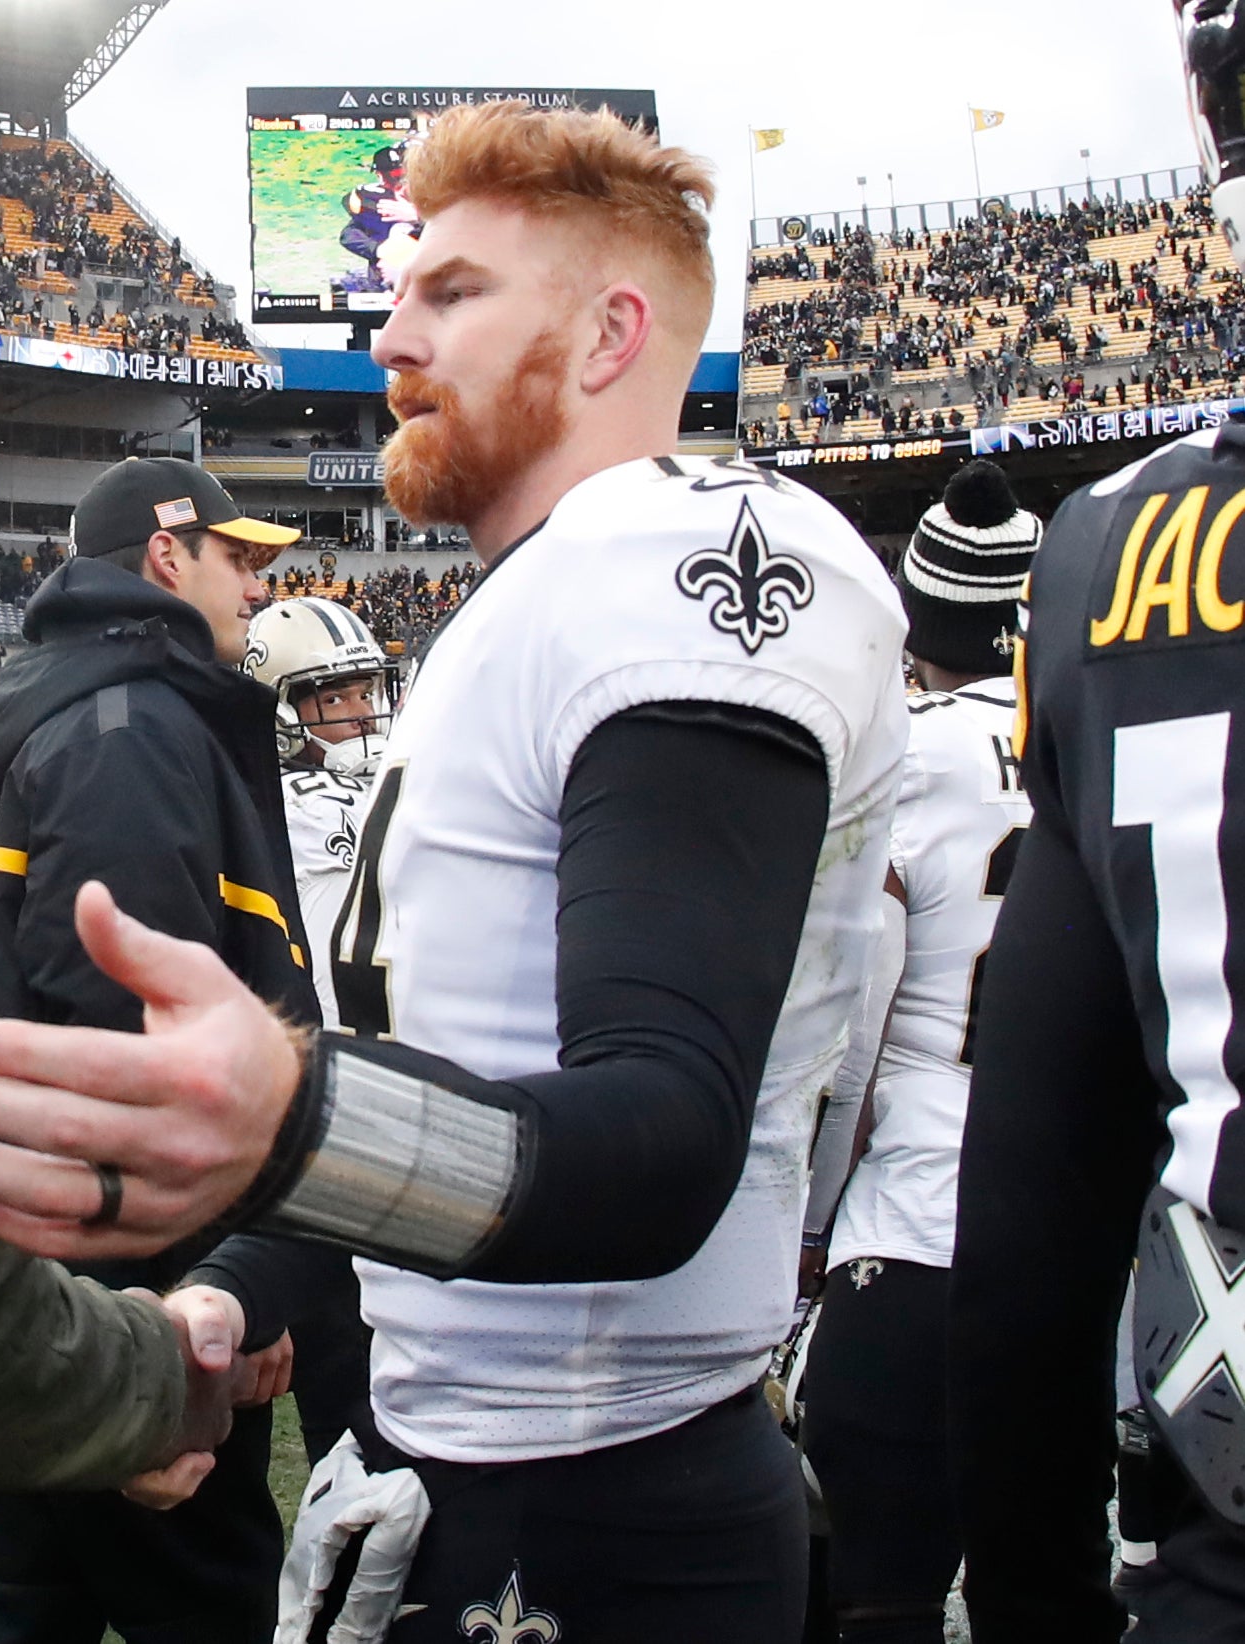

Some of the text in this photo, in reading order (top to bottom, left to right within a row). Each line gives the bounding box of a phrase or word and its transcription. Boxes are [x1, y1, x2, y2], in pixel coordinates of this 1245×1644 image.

[366, 92, 568, 107] ACRISURE STADIUM
[273, 298, 318, 306] ACRISURE
[776, 449, 812, 466] TEXT
[871, 444, 890, 460] TO
